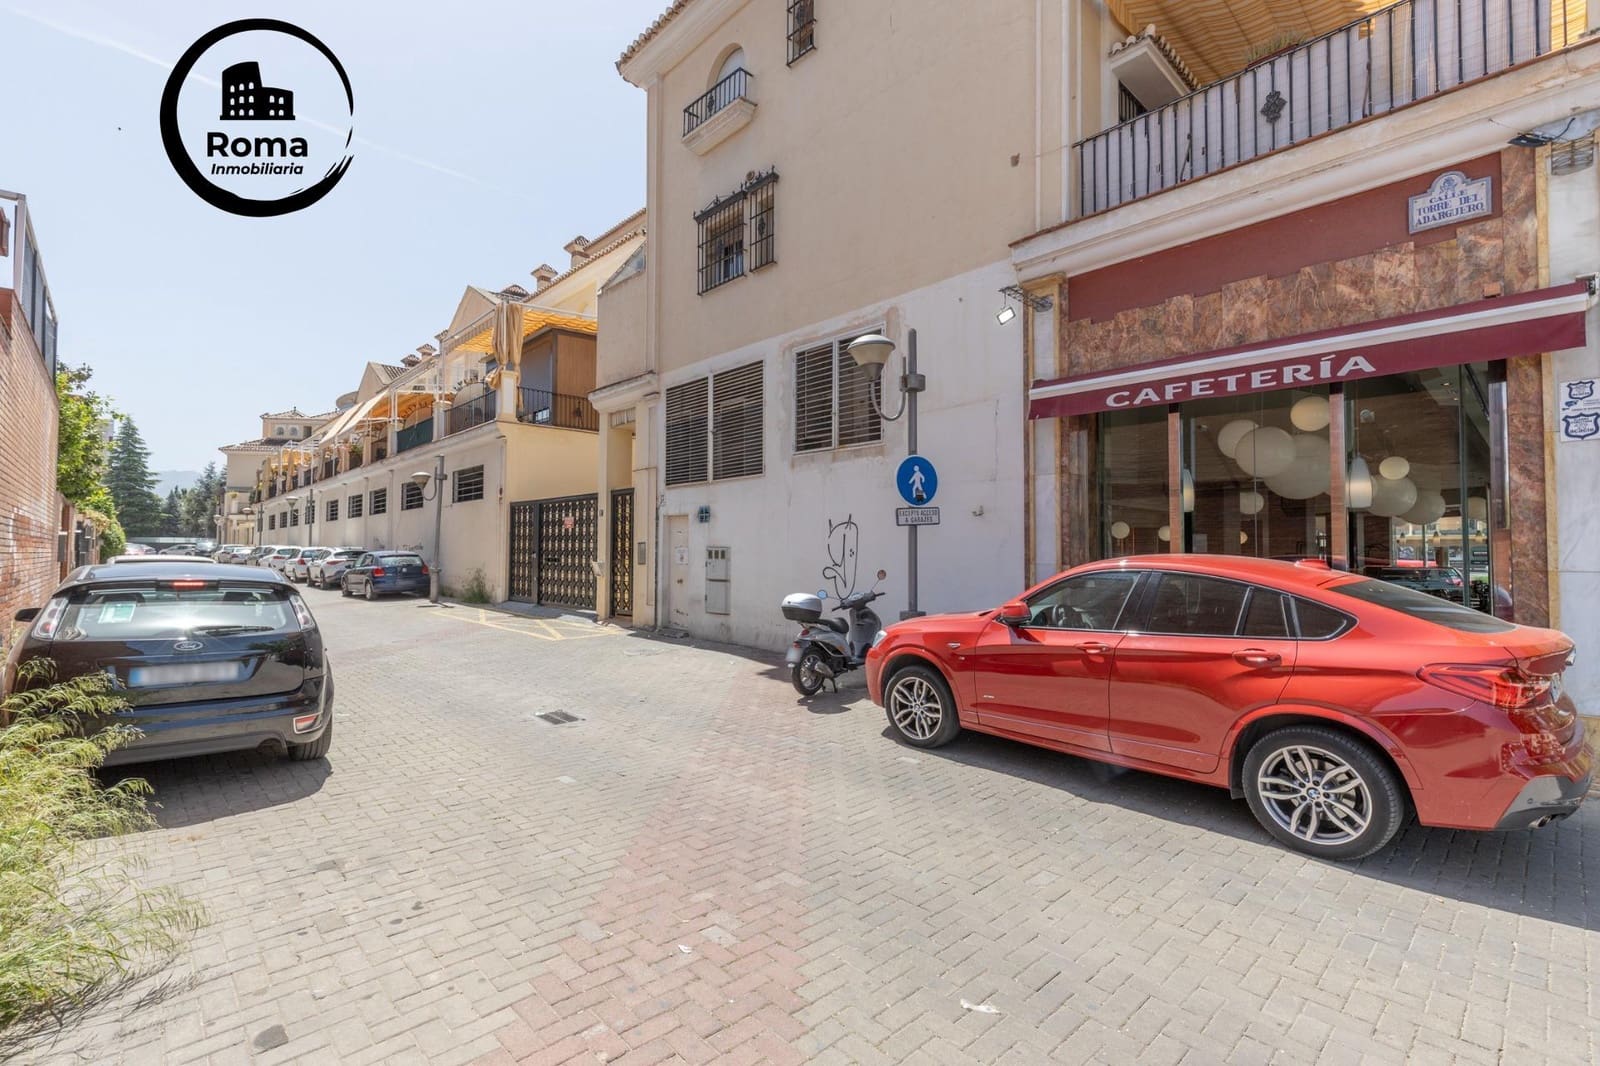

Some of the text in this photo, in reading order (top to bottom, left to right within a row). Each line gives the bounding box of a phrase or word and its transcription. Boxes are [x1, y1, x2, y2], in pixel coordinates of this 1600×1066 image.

[1417, 194, 1479, 216] TORRE DEL
[1429, 190, 1467, 203] CALLE
[1105, 354, 1377, 407] CAFETERÍA
